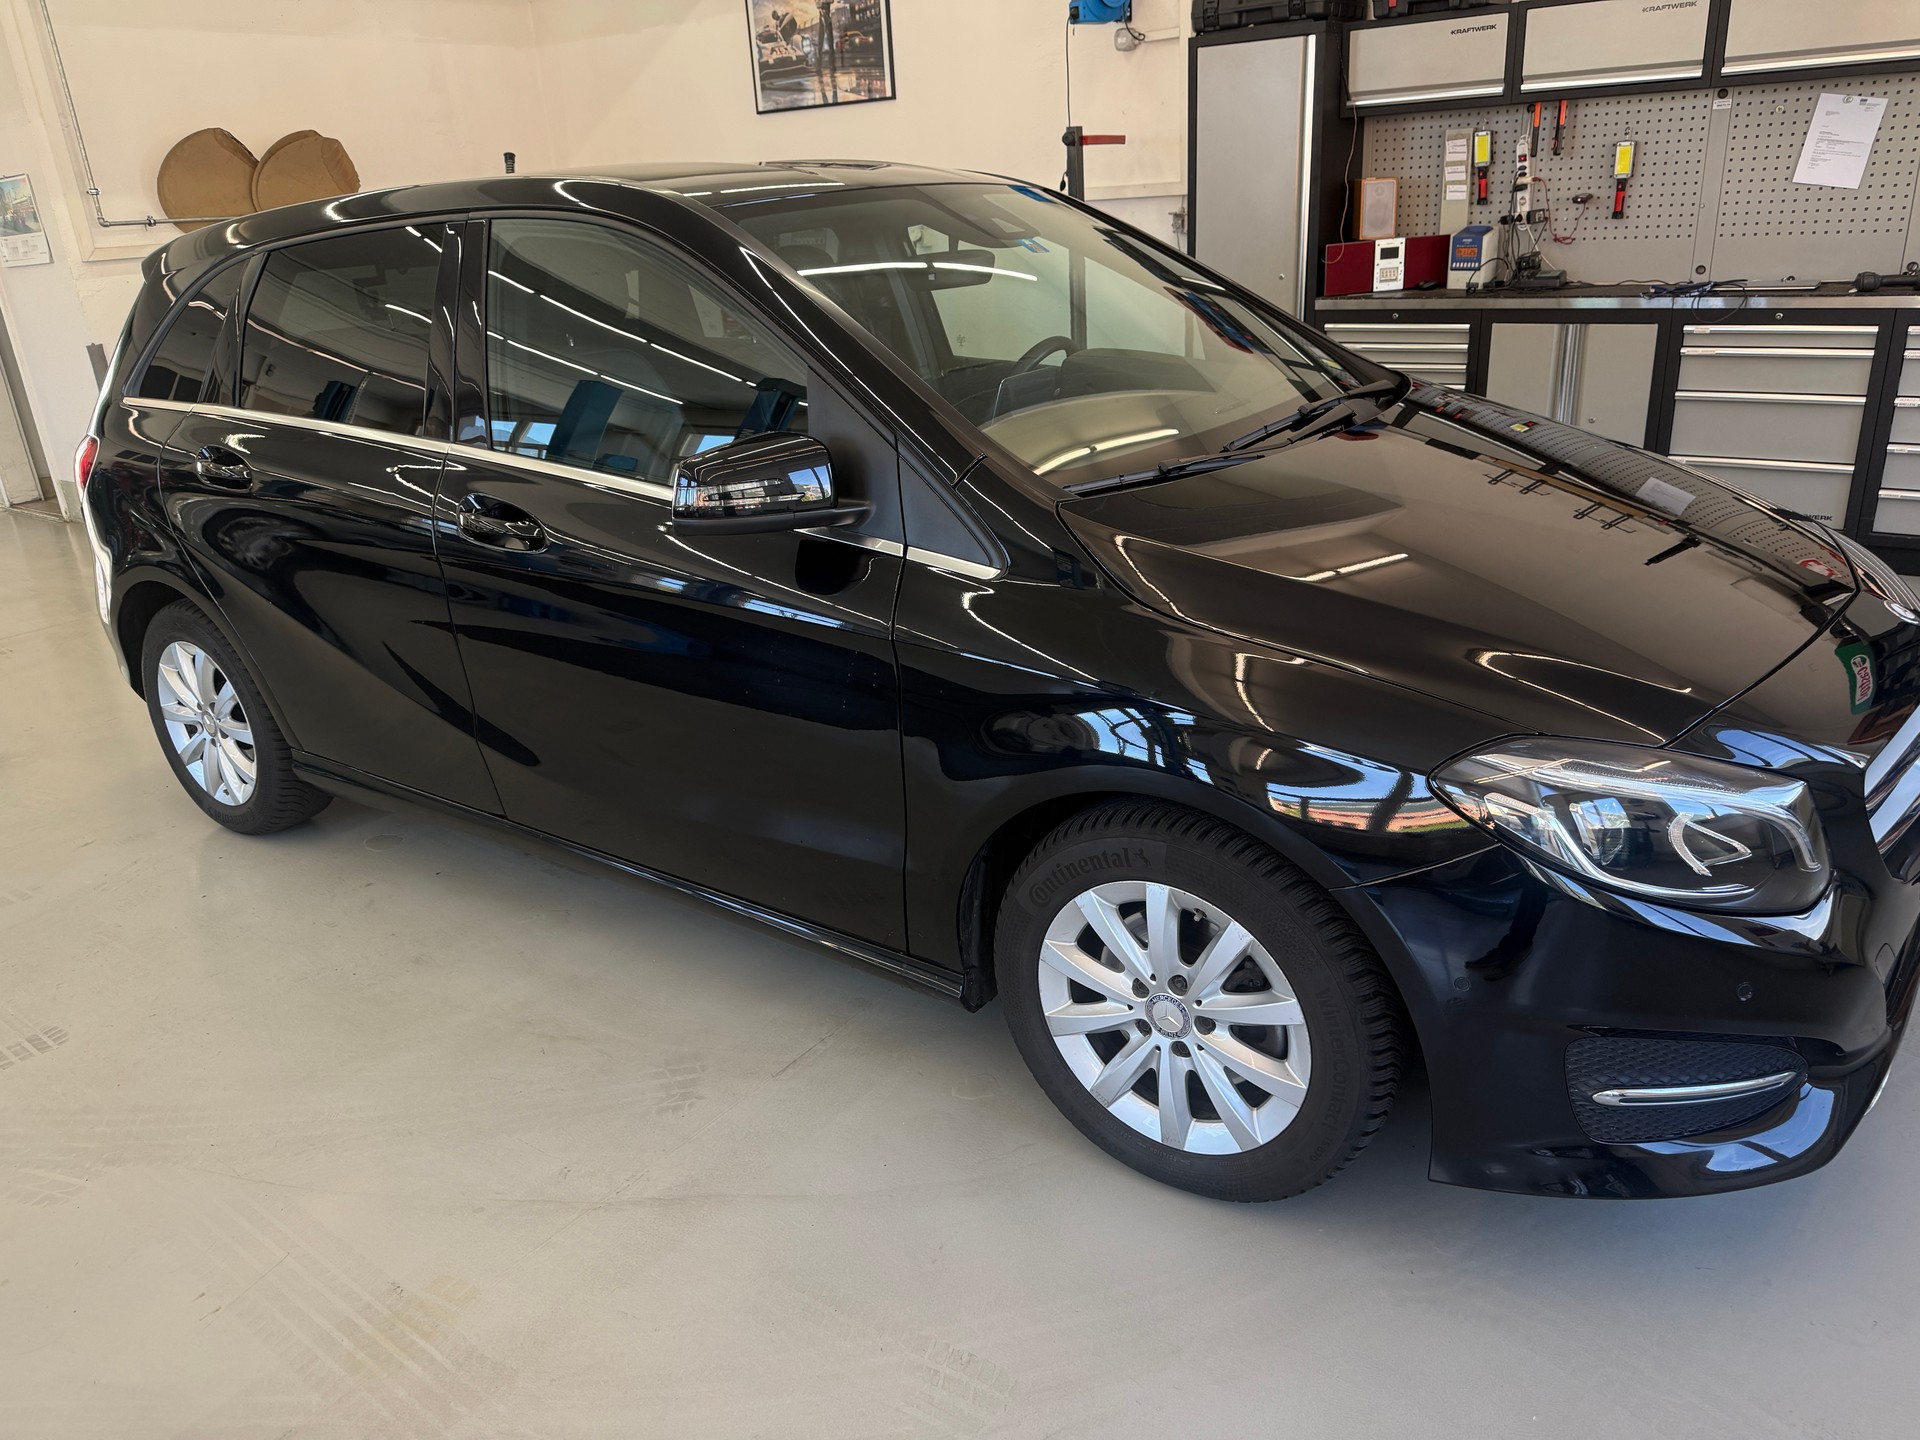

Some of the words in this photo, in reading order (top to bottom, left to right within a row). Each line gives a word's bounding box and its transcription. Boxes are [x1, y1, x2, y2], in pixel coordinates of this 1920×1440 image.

[1641, 0, 1698, 13] KRAFTWERK
[1450, 23, 1497, 35] KRAFTWERK
[1030, 847, 1133, 908] Continental
[1151, 995, 1184, 1011] MERCEDES
